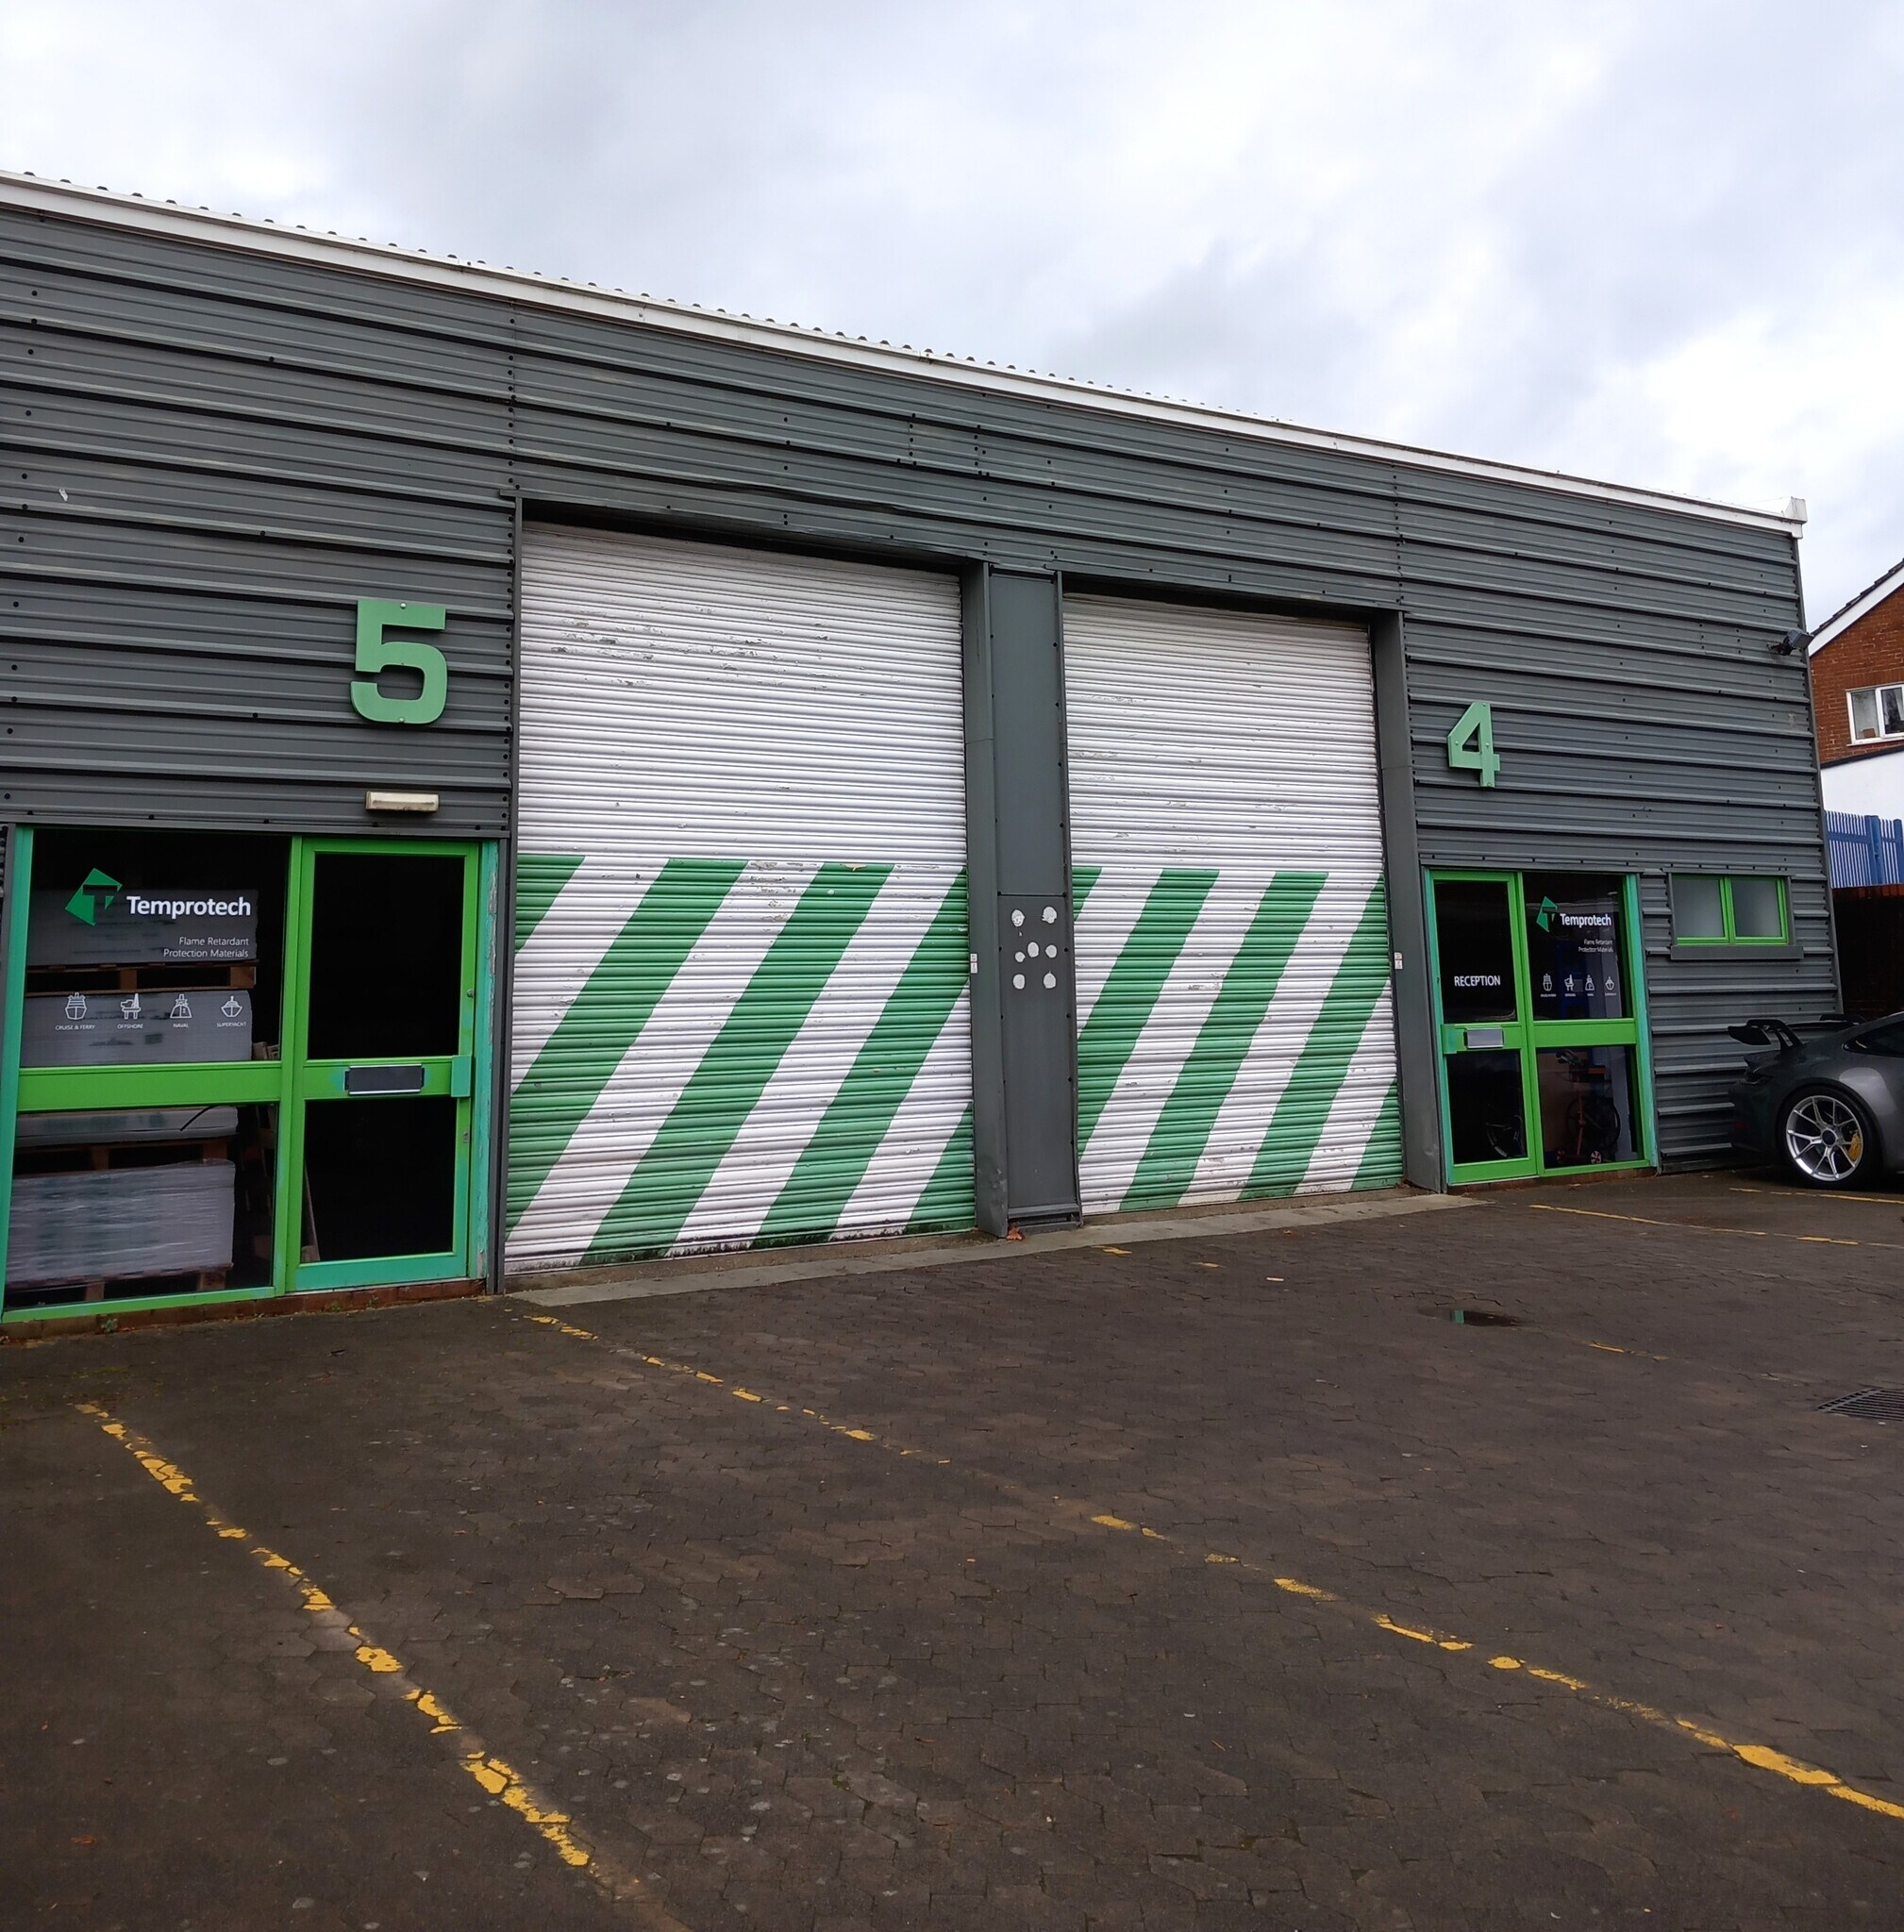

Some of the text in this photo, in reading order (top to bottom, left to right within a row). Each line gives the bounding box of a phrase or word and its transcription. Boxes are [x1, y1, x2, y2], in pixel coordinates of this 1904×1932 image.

[350, 598, 448, 724] 5
[1447, 700, 1501, 788] 4
[126, 895, 251, 919] Temprotech
[1560, 912, 1612, 928] Temprotech
[178, 936, 249, 946] Flame Retardant
[163, 948, 249, 958] Protection Materials
[1454, 974, 1501, 987] RECEPTION
